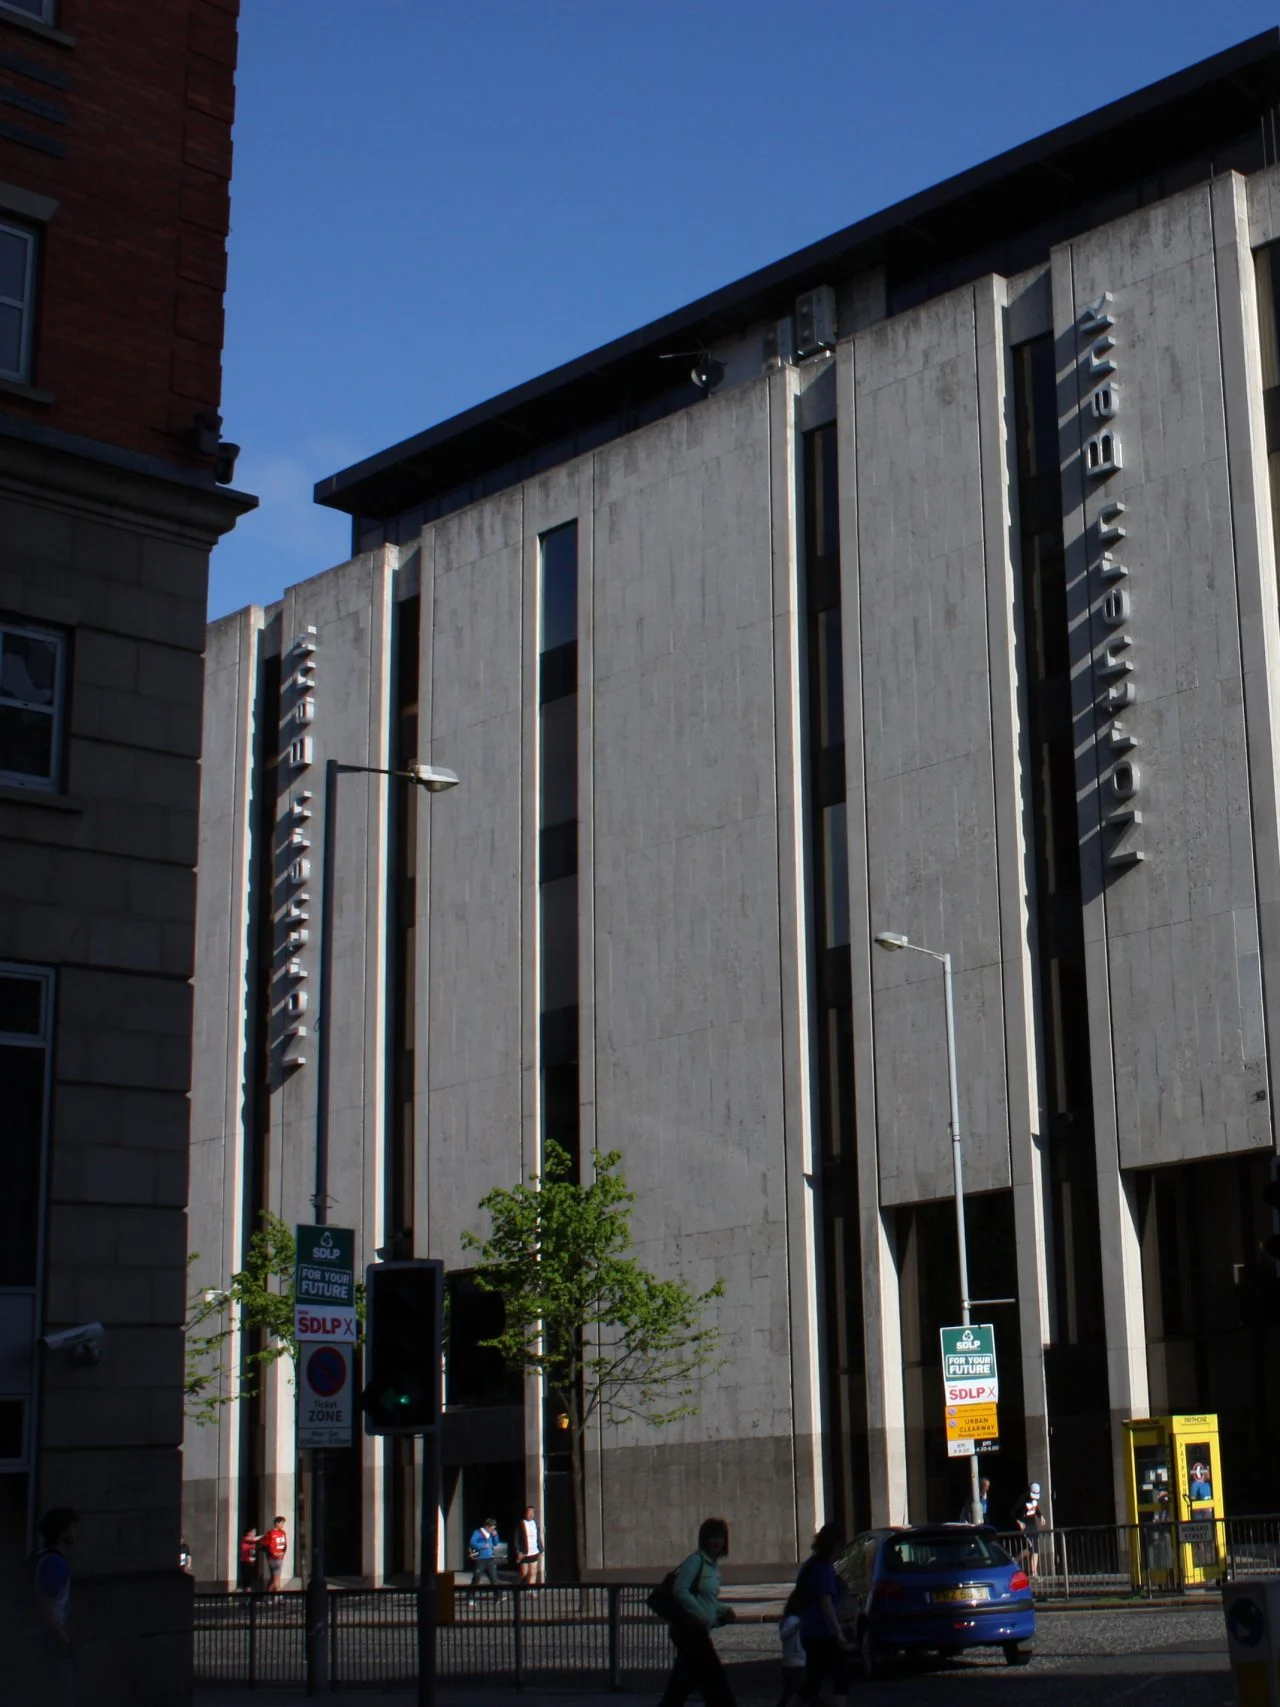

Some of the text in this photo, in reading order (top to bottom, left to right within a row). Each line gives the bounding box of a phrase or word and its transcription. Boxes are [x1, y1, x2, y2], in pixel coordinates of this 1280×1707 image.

[1080, 291, 1145, 866] Northern Bank
[283, 626, 317, 1066] Northern Bank
[312, 1248, 340, 1260] SDLP
[303, 1269, 350, 1285] FOR YOUR
[302, 1281, 348, 1299] FUTURE
[299, 1316, 341, 1335] SDLP
[956, 1340, 981, 1350] SDLP
[949, 1355, 991, 1364] FOR YOUR
[950, 1364, 992, 1375] FUTURE
[949, 1387, 985, 1400] SDLP
[308, 1410, 343, 1422] ZONE
[959, 1425, 995, 1433] CLEARWAY
[1181, 1525, 1209, 1533] HOWARD
